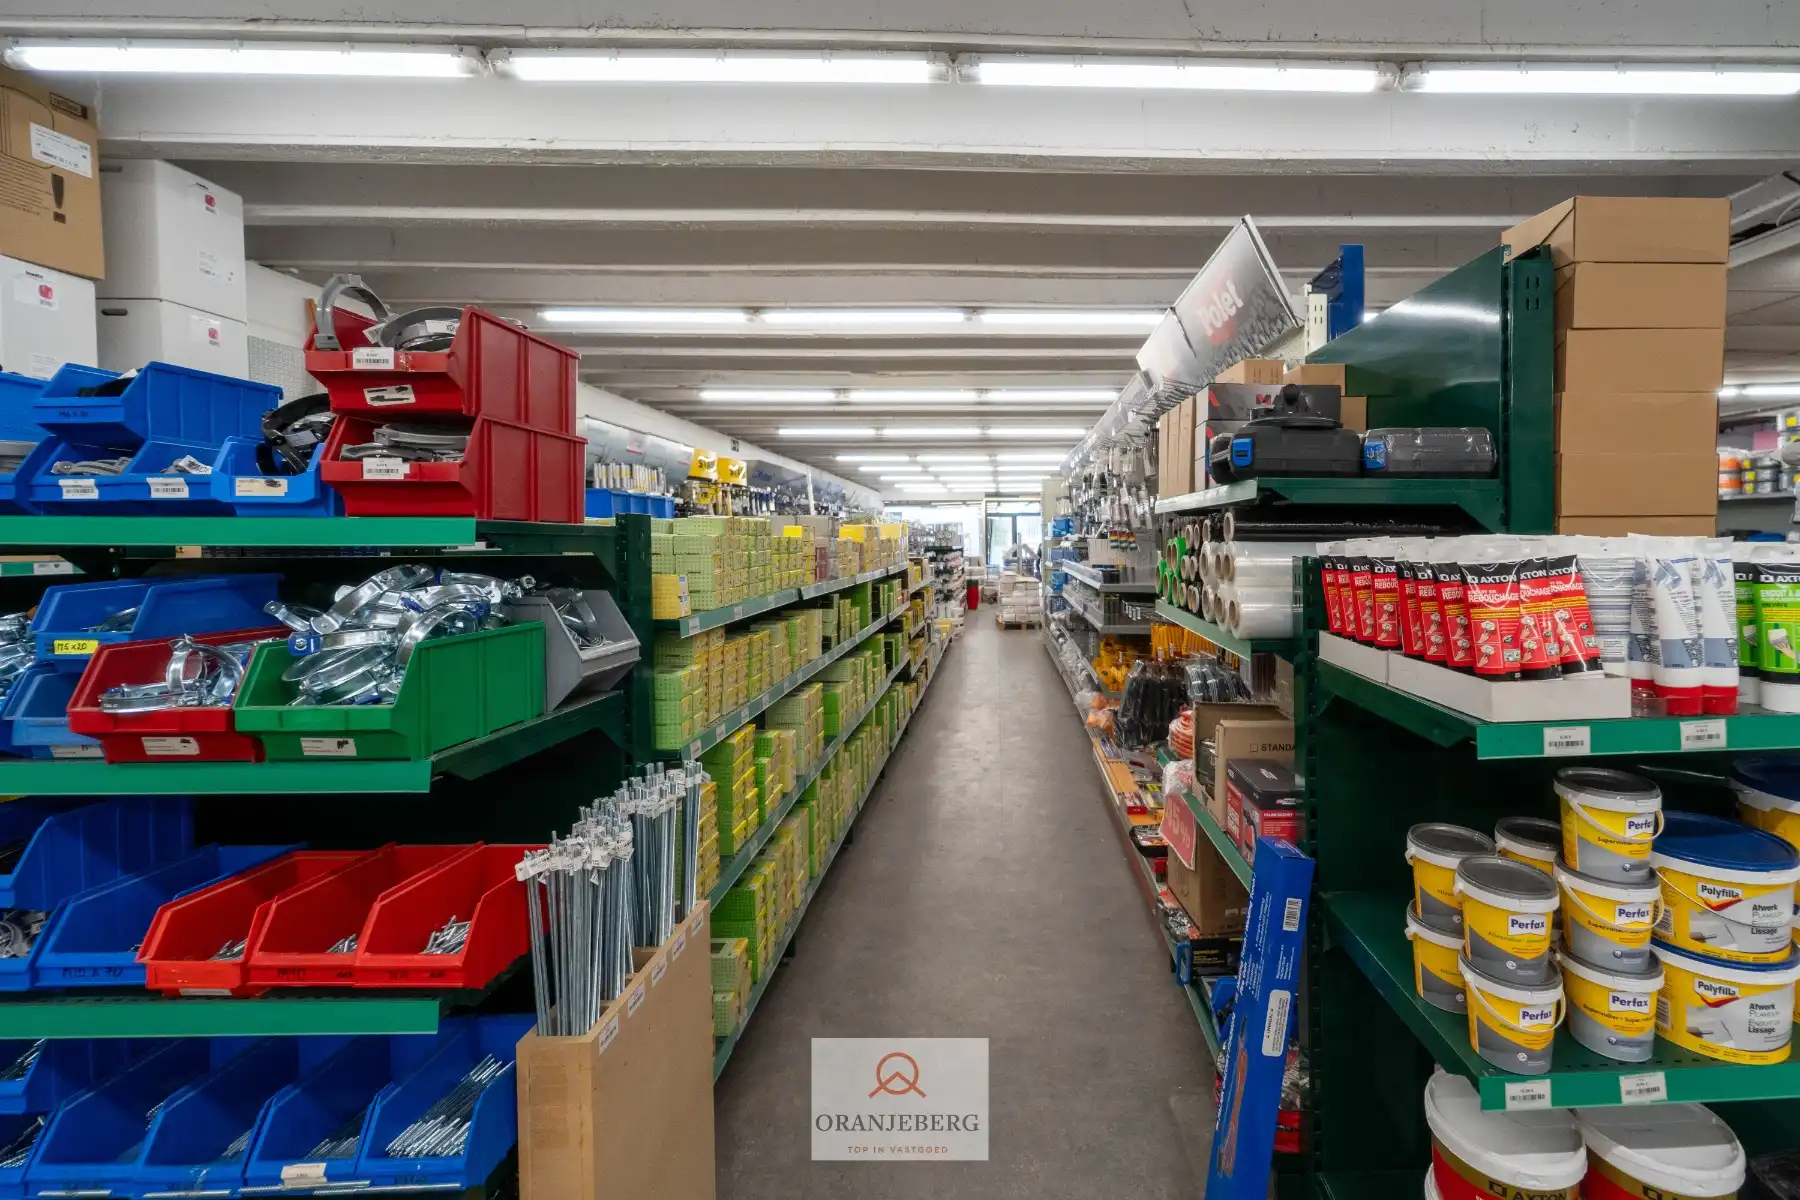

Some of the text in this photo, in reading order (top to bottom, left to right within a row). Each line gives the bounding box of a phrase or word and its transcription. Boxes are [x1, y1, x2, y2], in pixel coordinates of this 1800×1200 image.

[1480, 574, 1518, 584] AXTON
[1468, 593, 1519, 602] REBOUCHAGE
[1701, 884, 1740, 899] Polyfilla
[1617, 908, 1650, 918] Perfax
[1510, 918, 1545, 929] Perfax
[1697, 980, 1737, 996] Polyfilla
[1611, 994, 1649, 1007] Perfax
[1521, 1009, 1553, 1021] Perfax
